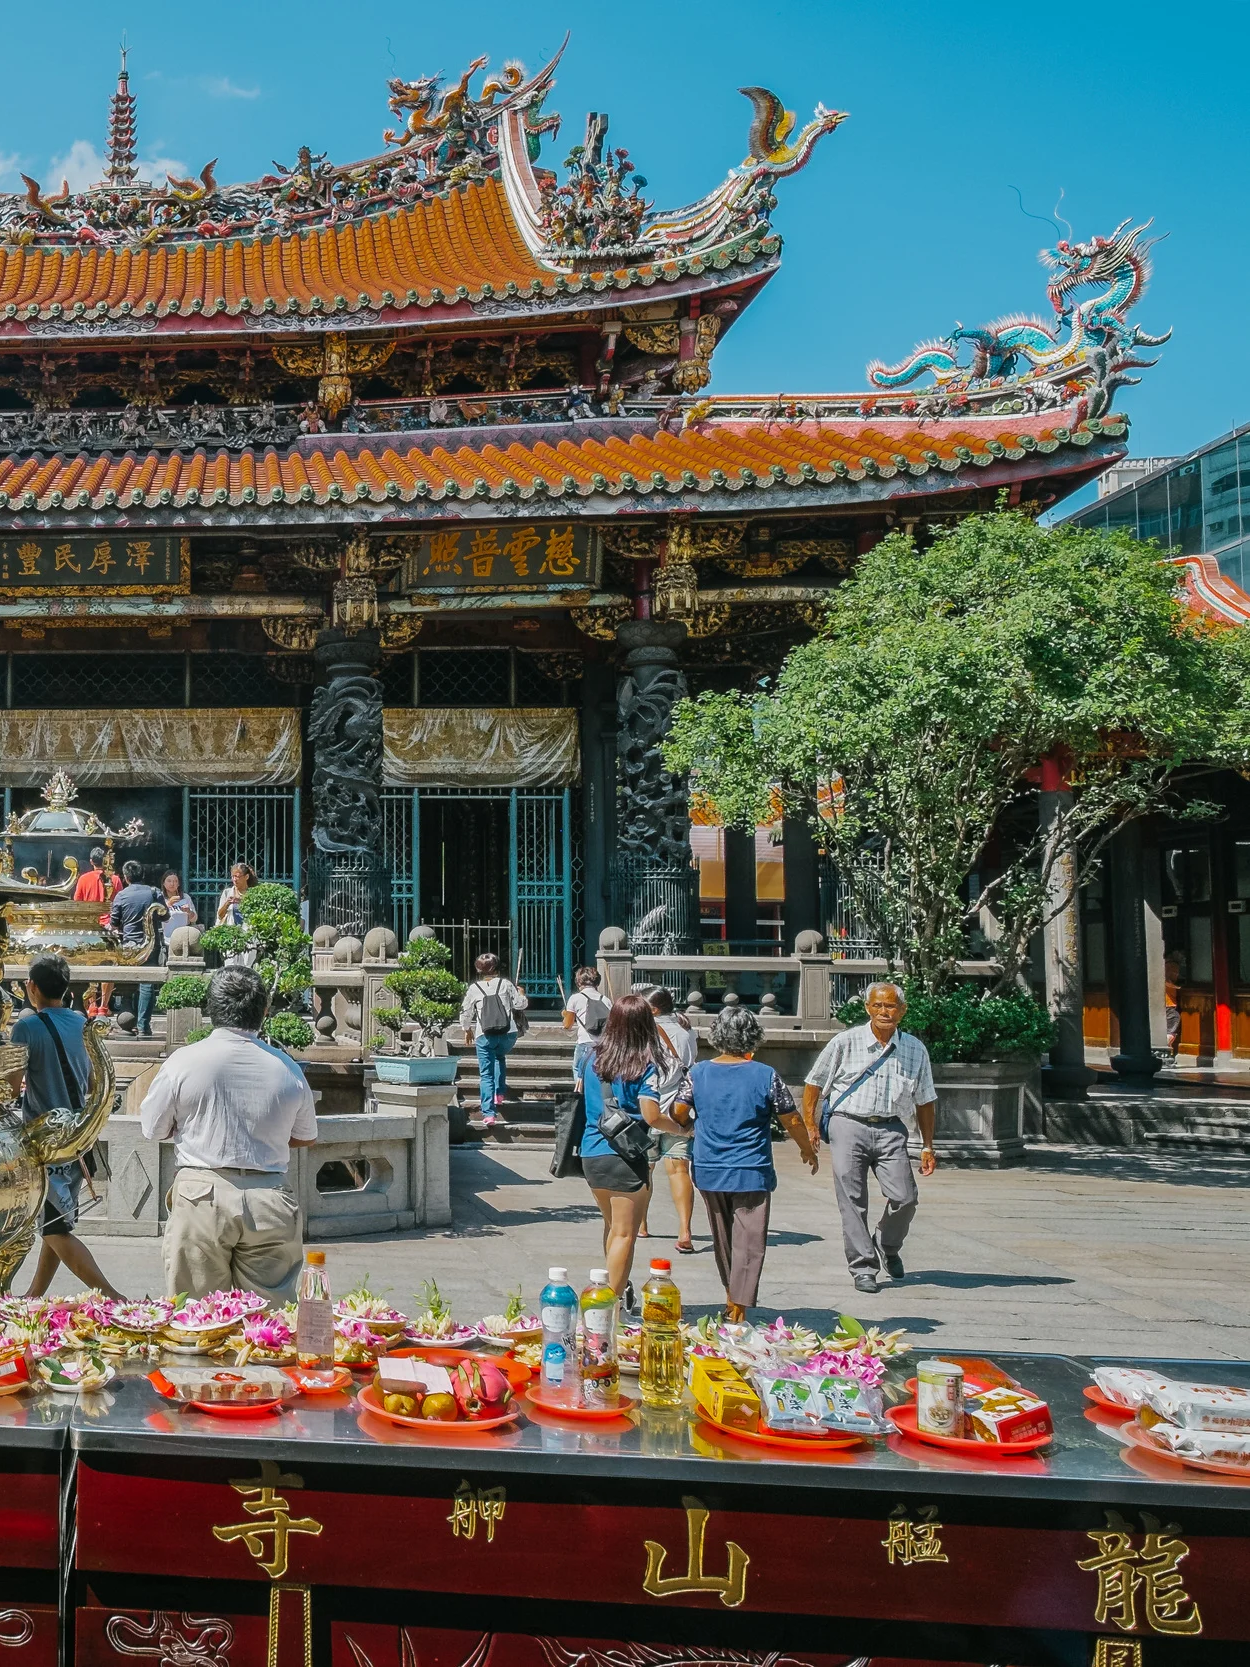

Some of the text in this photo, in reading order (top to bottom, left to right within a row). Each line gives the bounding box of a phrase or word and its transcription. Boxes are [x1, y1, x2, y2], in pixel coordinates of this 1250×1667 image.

[212, 1459, 1203, 1635] 龍 艋 山 舺 寺
